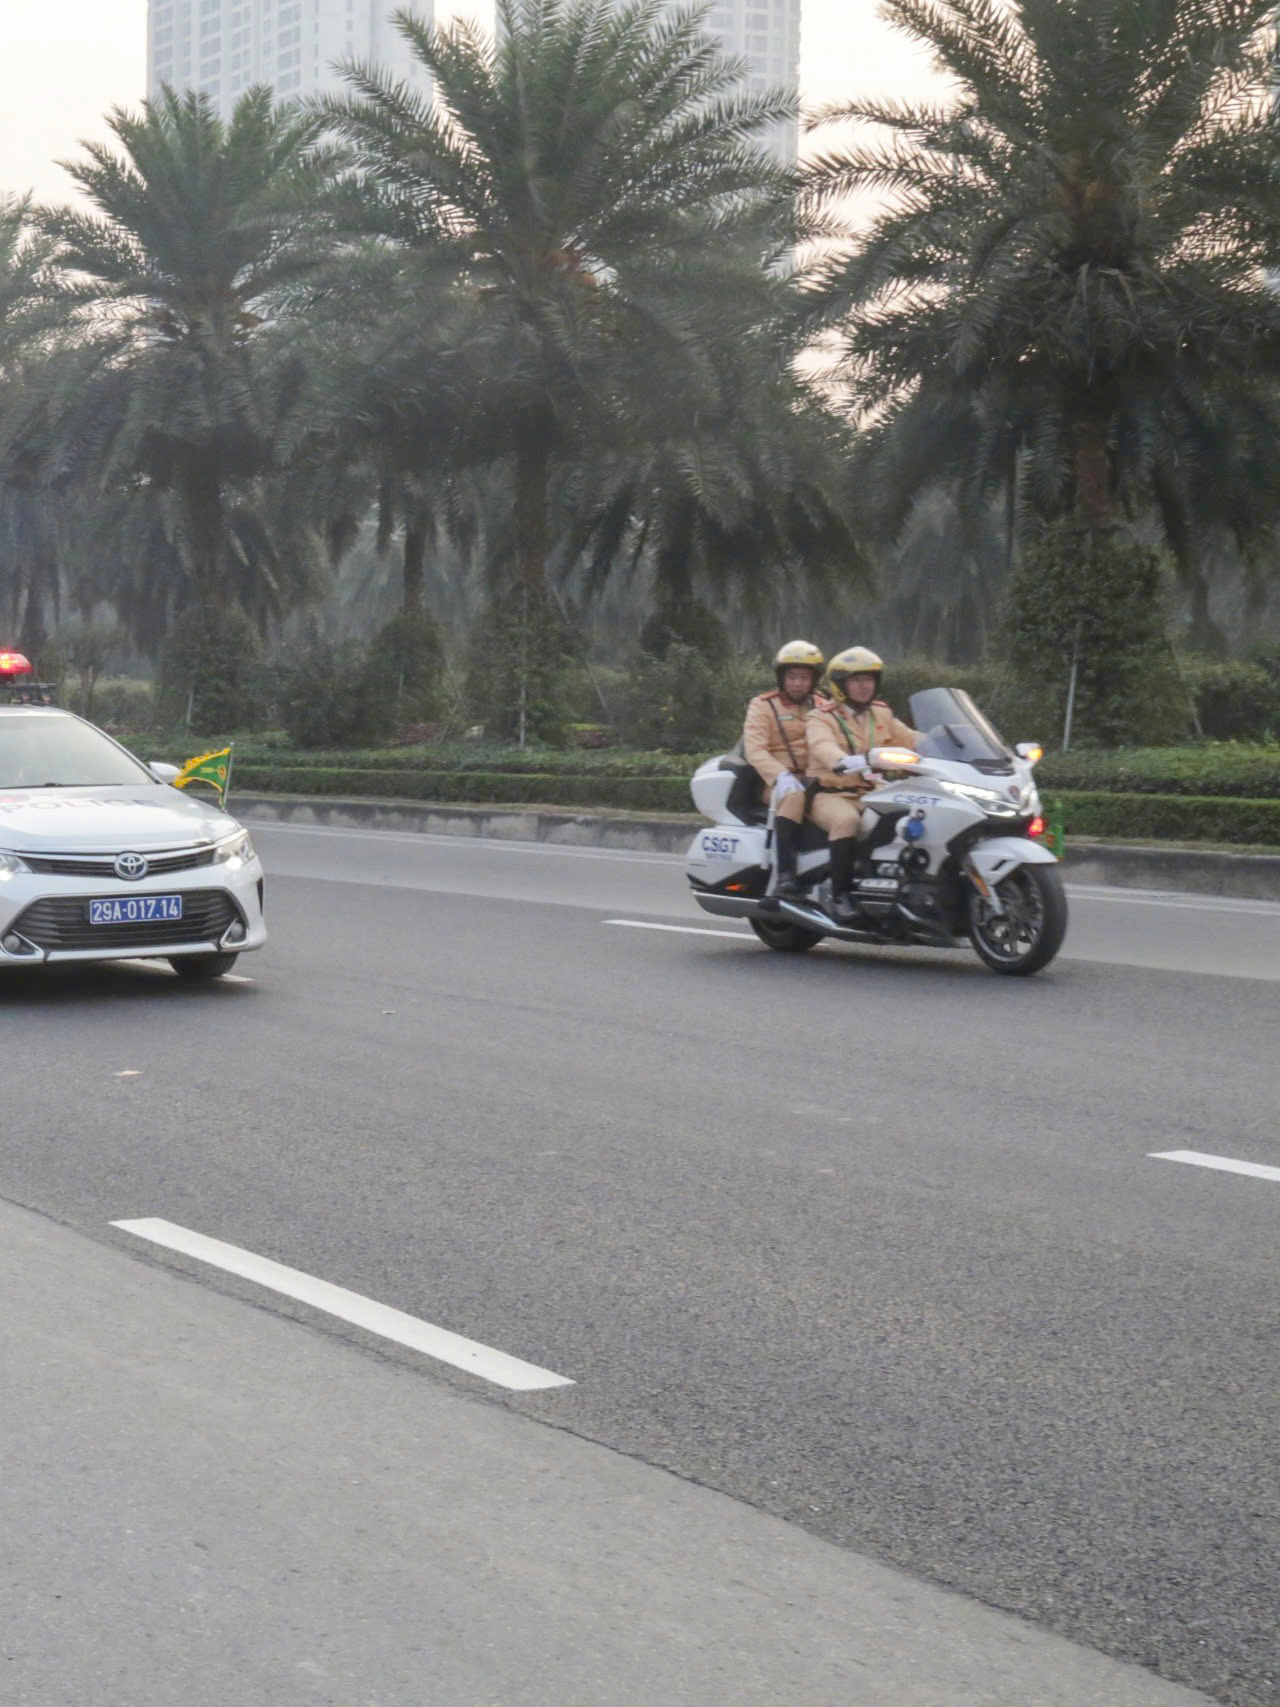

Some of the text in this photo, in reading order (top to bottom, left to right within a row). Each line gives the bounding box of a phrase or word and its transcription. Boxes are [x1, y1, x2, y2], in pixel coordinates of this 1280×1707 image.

[893, 795, 942, 807] CSGT
[702, 836, 739, 853] CSGT
[93, 898, 179, 921] 29A-017.14
